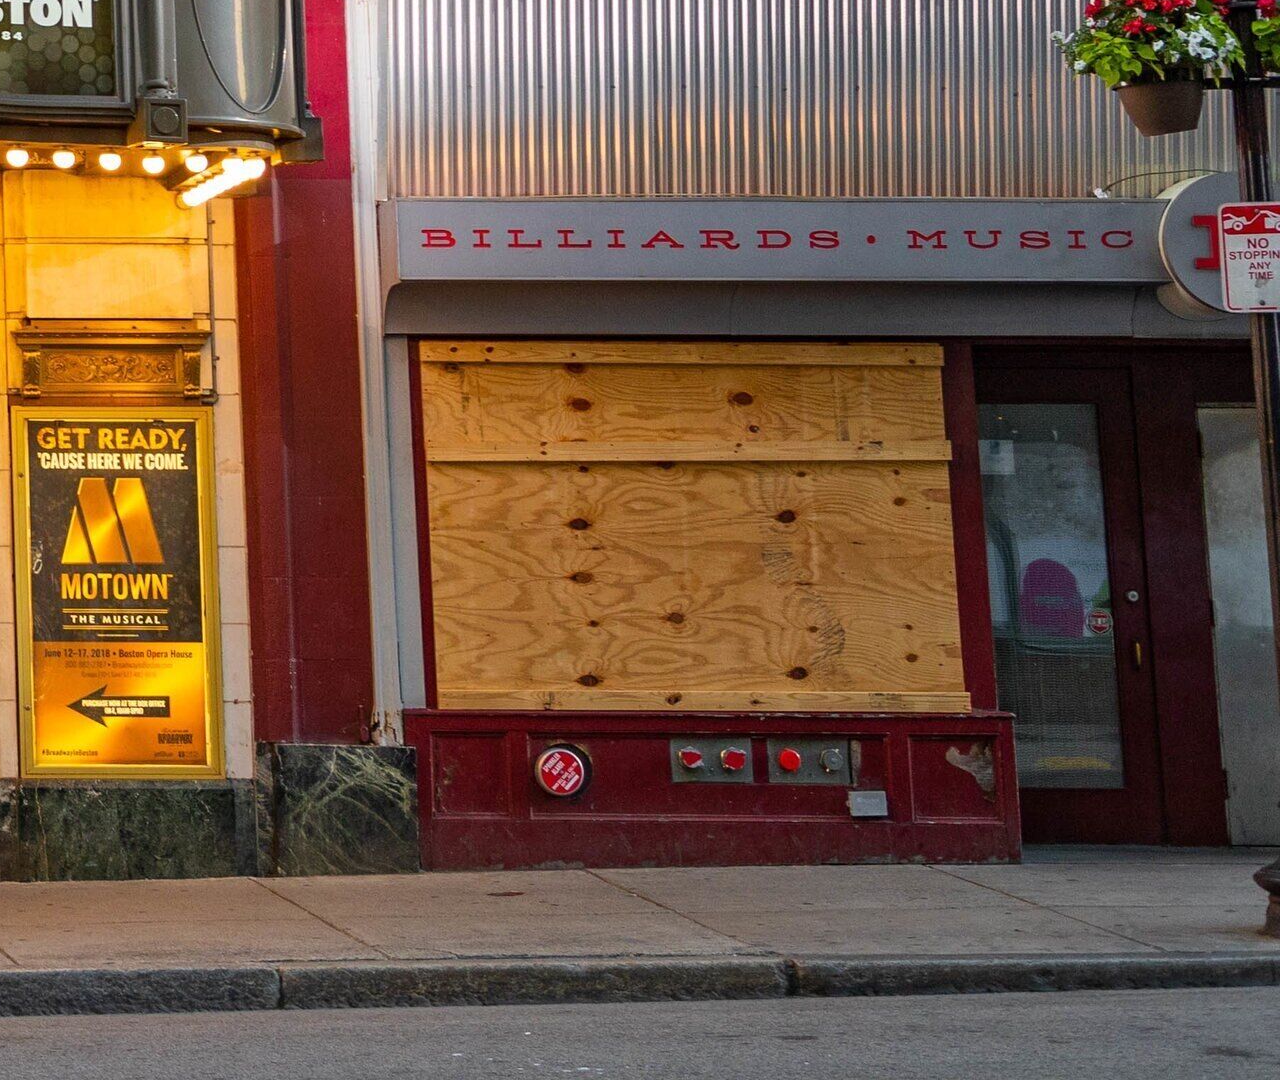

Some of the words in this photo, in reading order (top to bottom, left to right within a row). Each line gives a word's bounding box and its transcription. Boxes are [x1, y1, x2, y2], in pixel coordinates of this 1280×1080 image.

[421, 227, 841, 250] BILLIARDS
[906, 228, 1135, 250] MUSIC
[1247, 237, 1269, 249] NO
[1229, 250, 1280, 260] STOPPIN
[1249, 261, 1271, 270] ANY
[1248, 271, 1274, 280] TIME
[36, 426, 90, 450] GET
[98, 427, 187, 452] READY,
[37, 452, 86, 470] 'CAUSE
[87, 452, 120, 470] HERE
[121, 453, 143, 470] WE
[145, 453, 189, 471] COME.
[70, 614, 95, 624] THE
[102, 614, 161, 625] MUSICAL
[44, 649, 61, 658] June
[91, 649, 111, 658] 2018
[119, 649, 144, 658] Boston
[147, 650, 168, 659] Opera
[170, 650, 193, 659] House
